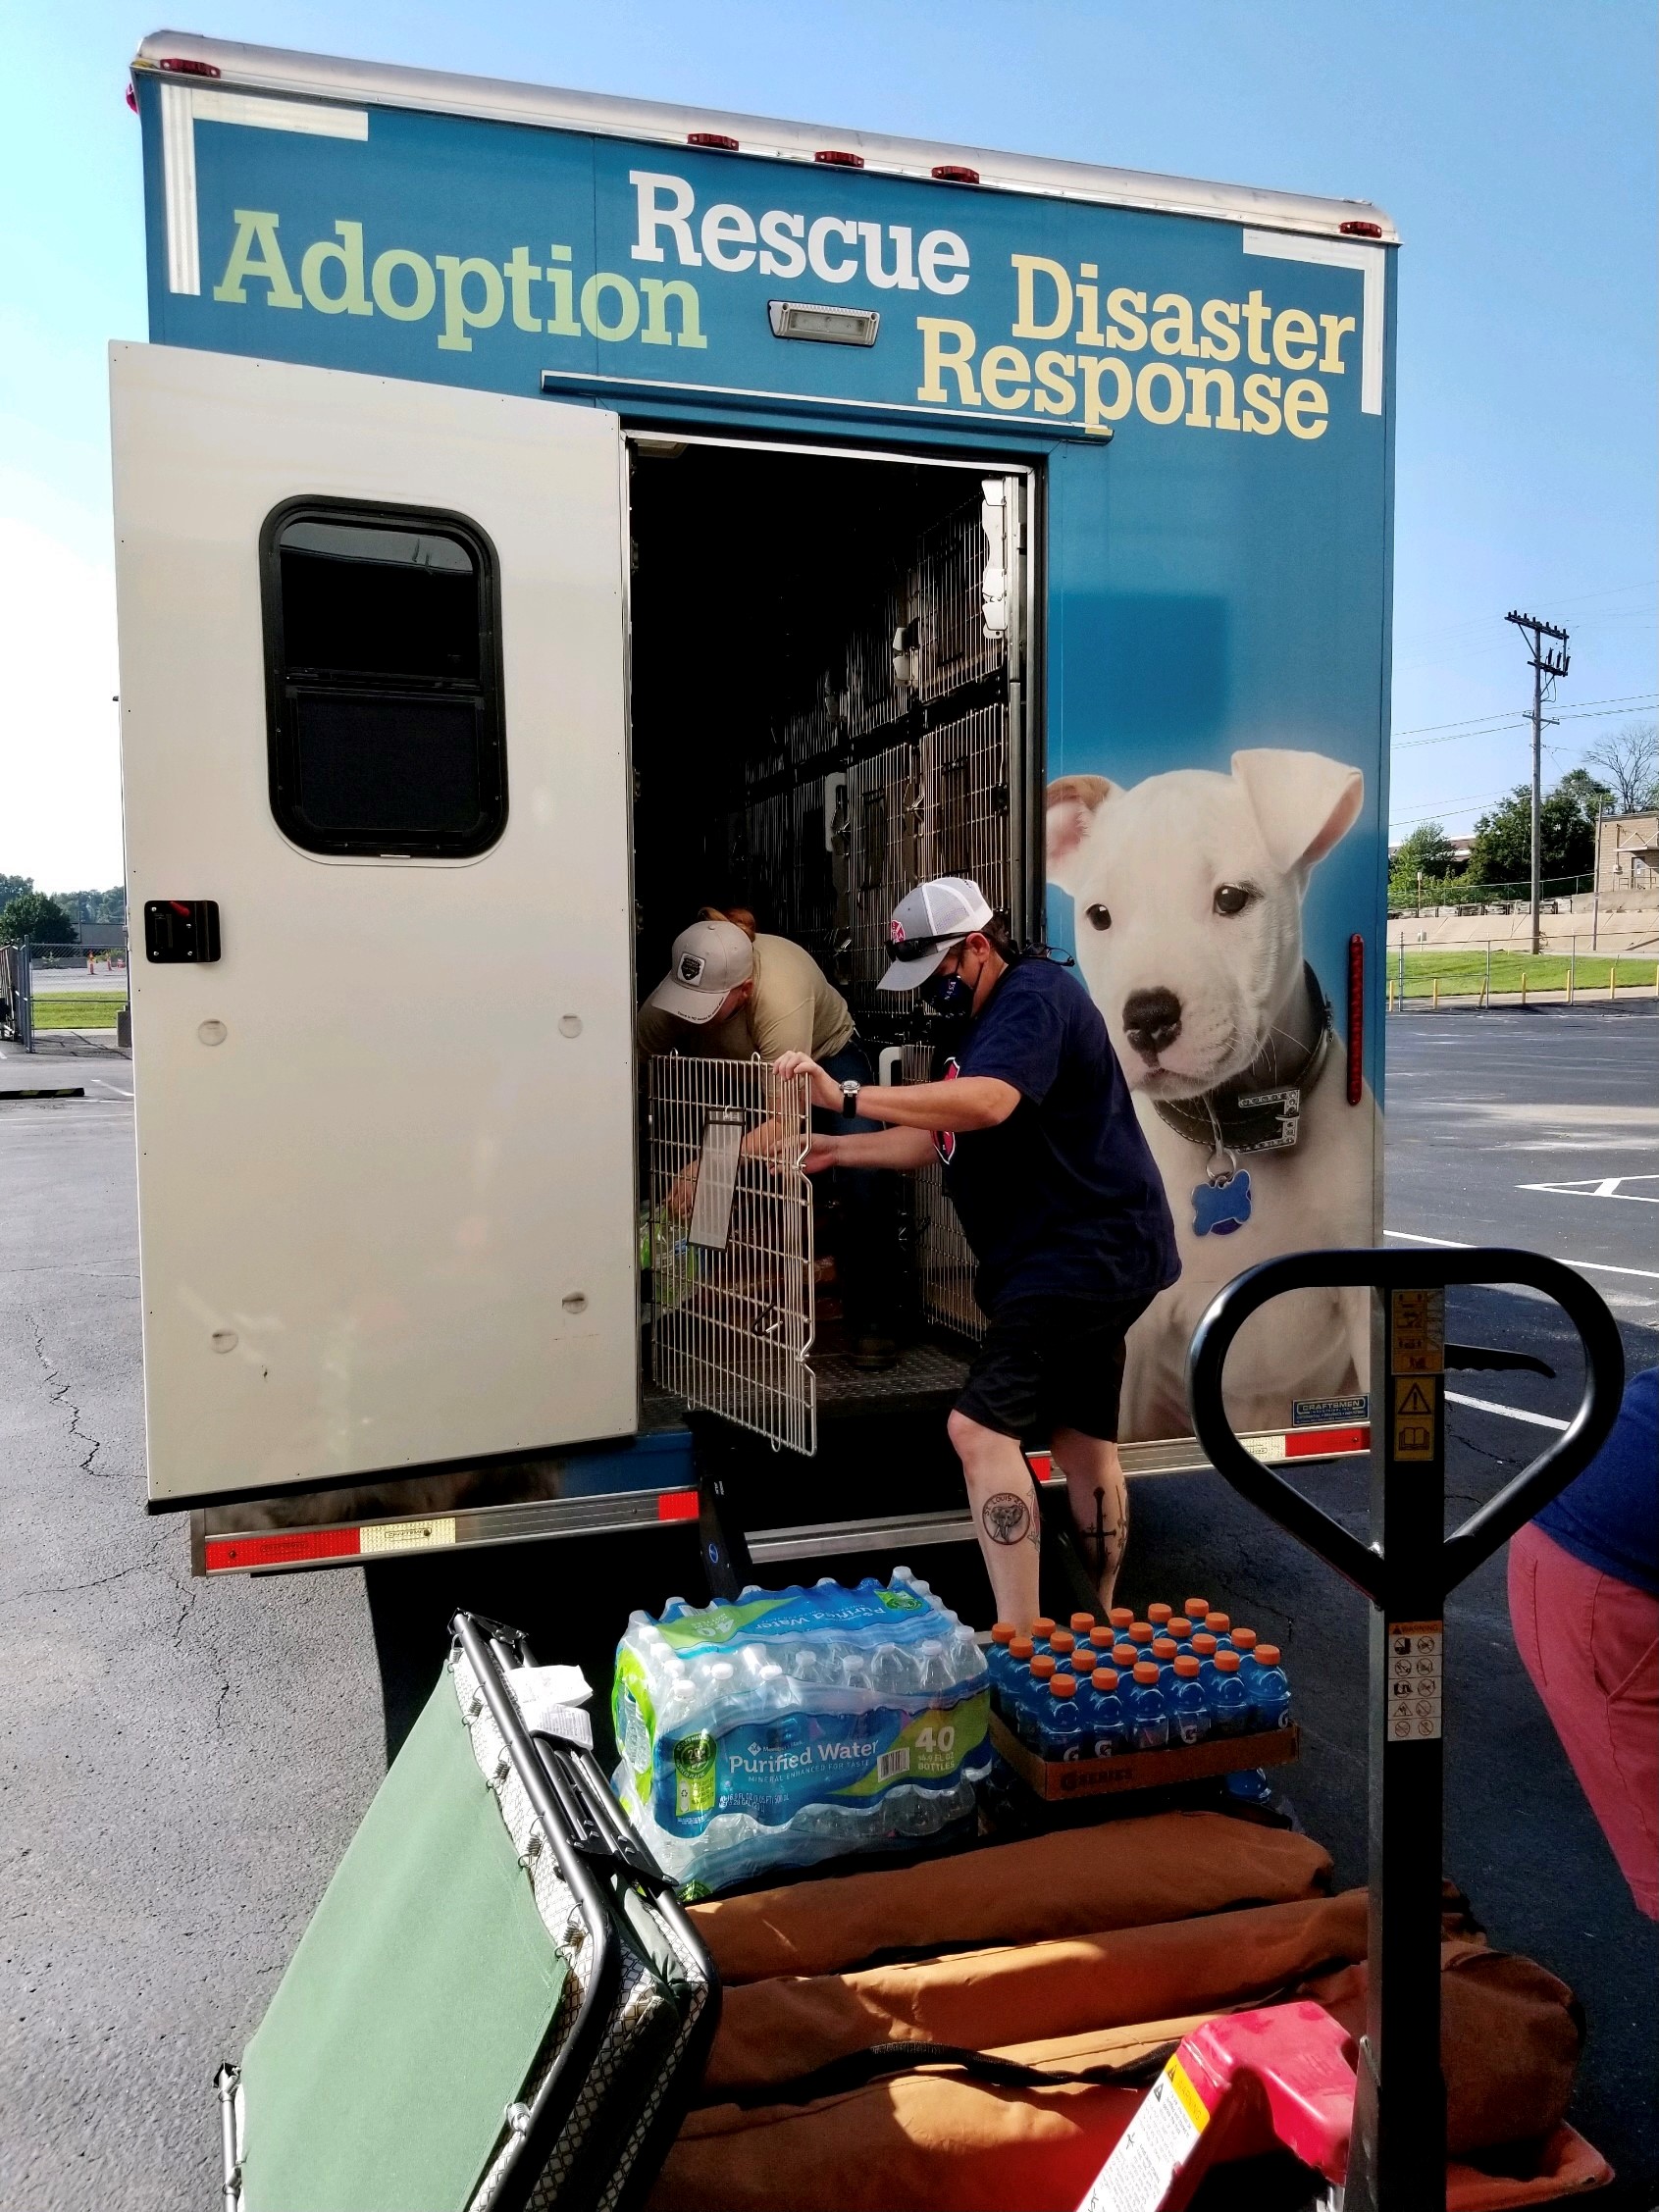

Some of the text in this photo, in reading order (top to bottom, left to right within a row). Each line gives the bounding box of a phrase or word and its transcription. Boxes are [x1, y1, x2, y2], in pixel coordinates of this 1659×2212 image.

[629, 170, 970, 295] Rescue
[213, 209, 707, 352] Adoption
[1011, 254, 1356, 374] Disaster
[916, 316, 1330, 440] Response
[1302, 1400, 1360, 1411] CRAFTSMEN
[992, 1495, 1011, 1504] LOUIS
[697, 1619, 735, 1637] 40
[1401, 1624, 1438, 1633] WARNING
[914, 1725, 955, 1753] 40
[1180, 1724, 1198, 1744] G
[729, 1739, 879, 1775] Purified Water
[1094, 1739, 1113, 1758] G
[786, 1765, 826, 1780] ENHANCED
[828, 1762, 844, 1772] FOR
[846, 1759, 870, 1769] TASTE
[917, 1760, 955, 1773] BOTTLES
[1177, 2080, 1202, 2121] WARNING
